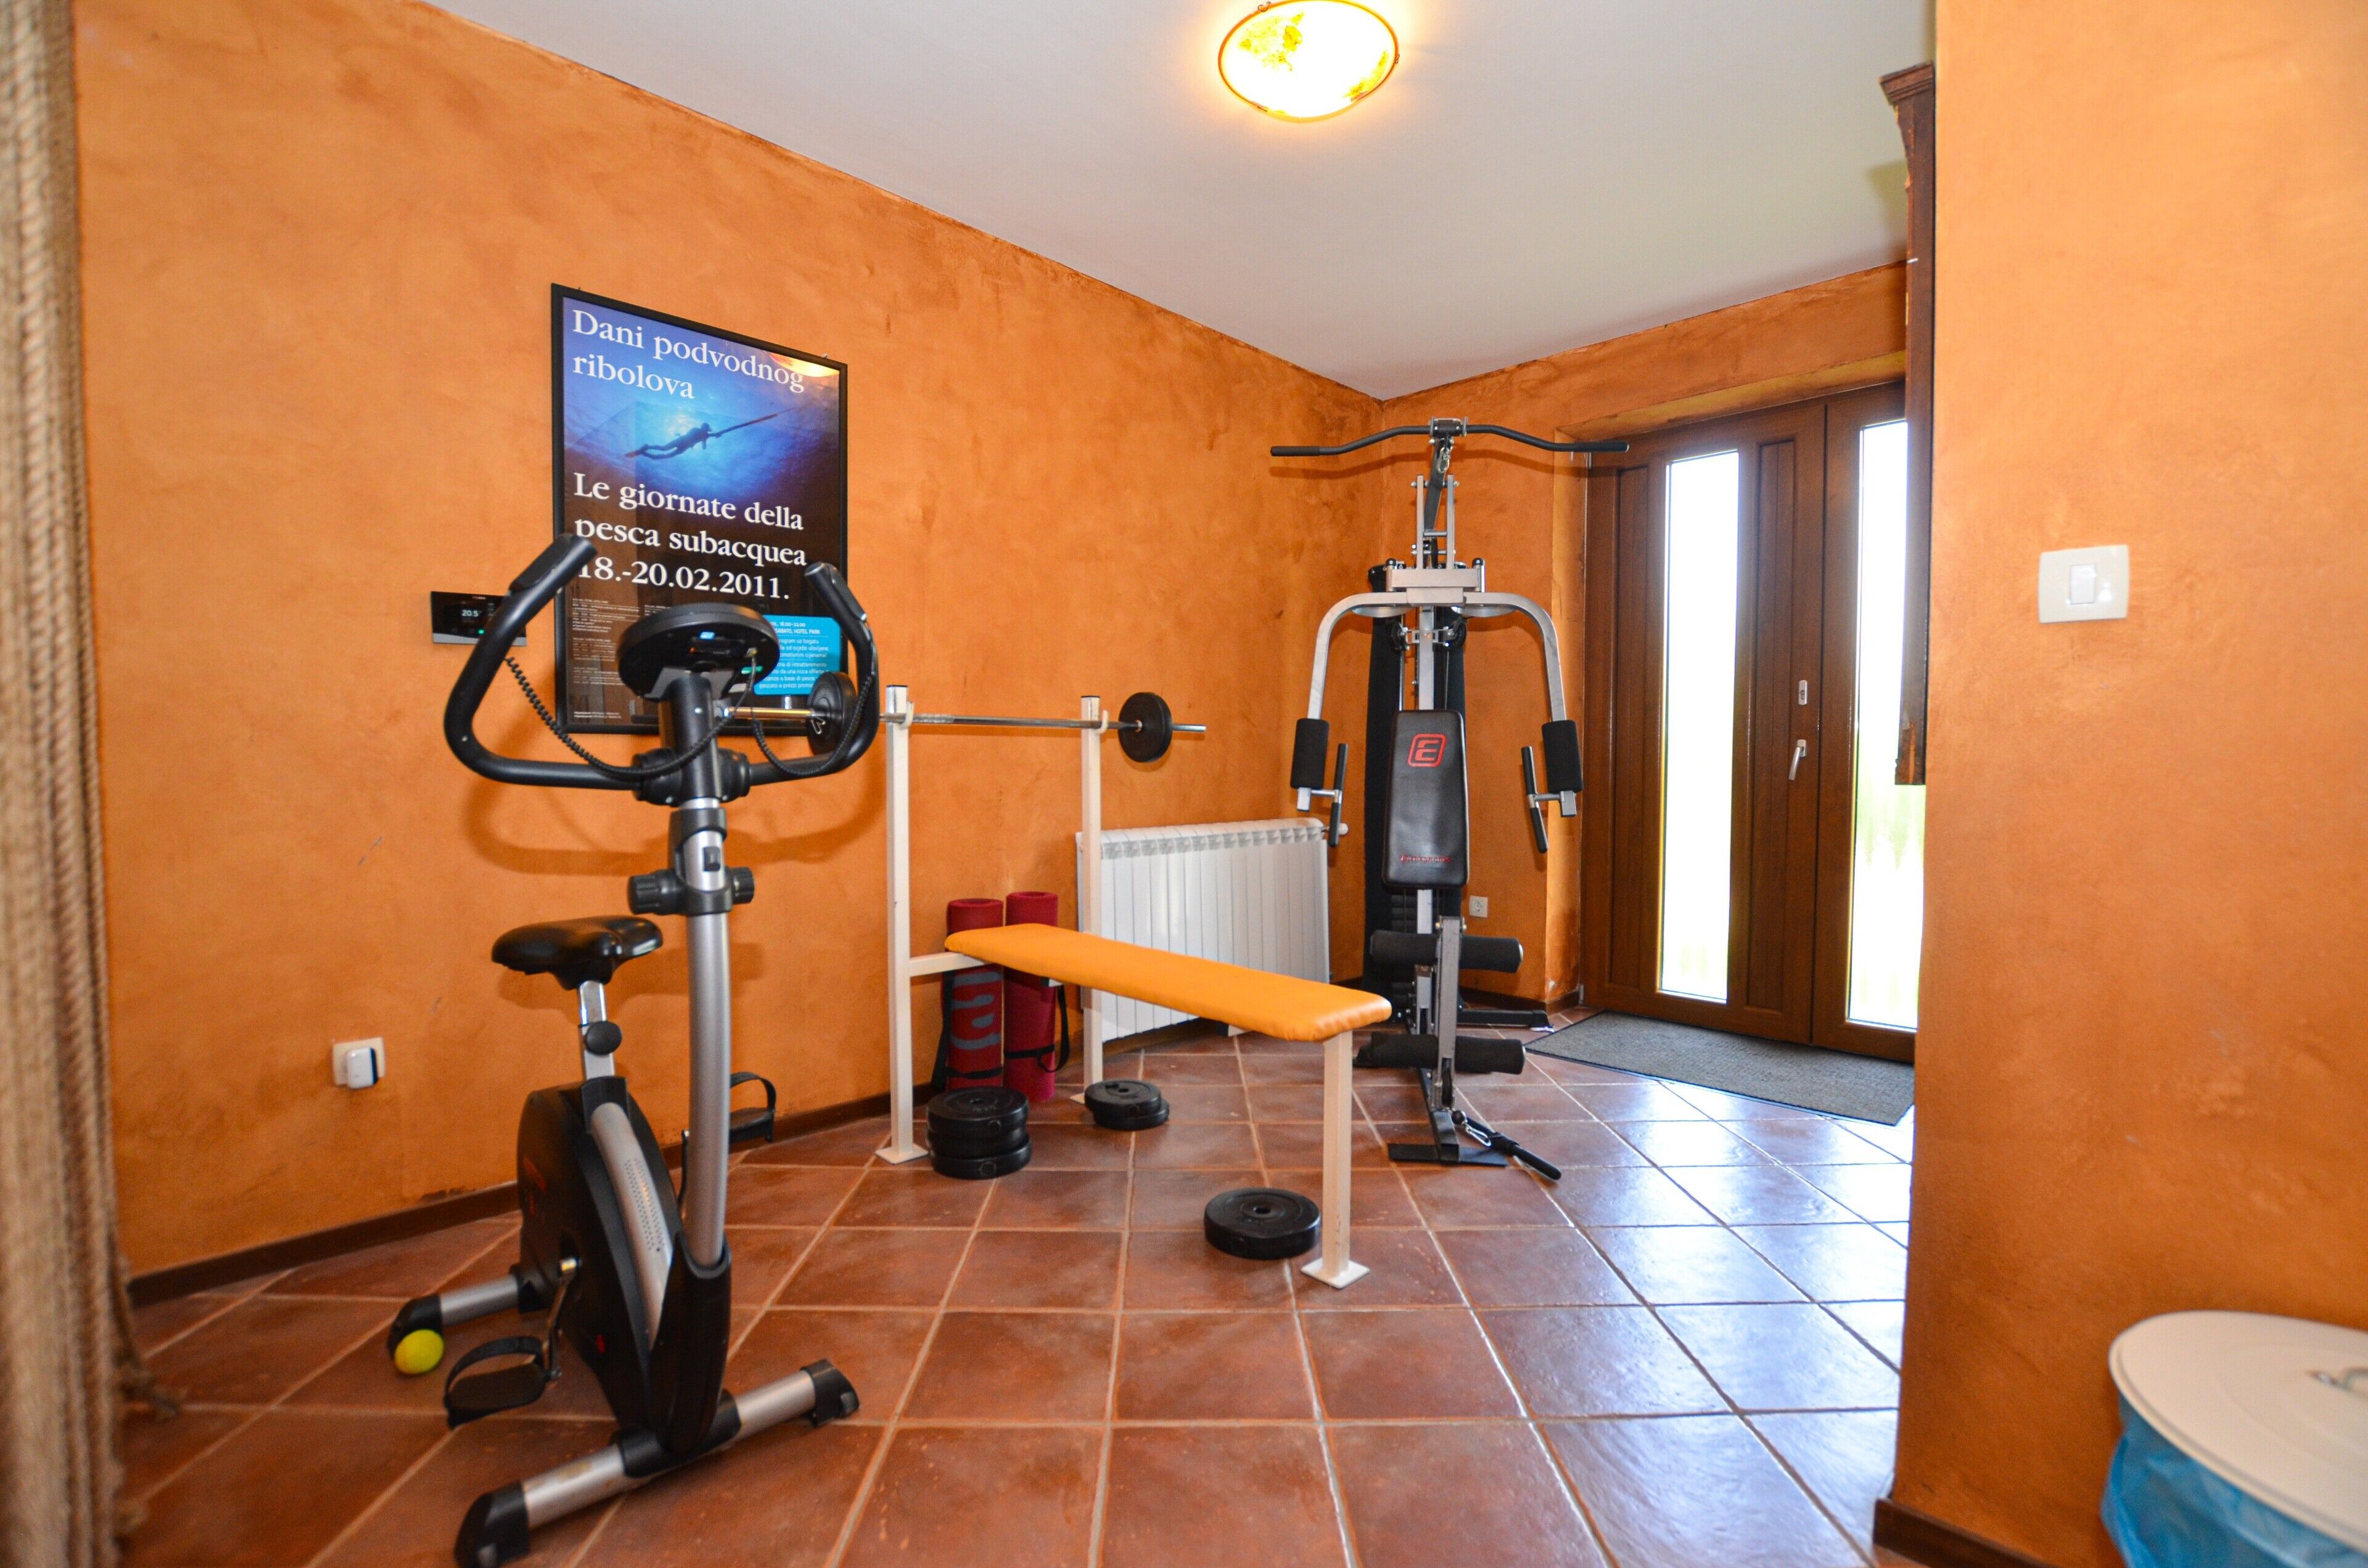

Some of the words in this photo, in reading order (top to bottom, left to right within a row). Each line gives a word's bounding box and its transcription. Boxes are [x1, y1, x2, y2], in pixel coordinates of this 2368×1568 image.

[572, 310, 644, 349] Dani
[652, 335, 805, 395] podvodnog
[572, 353, 694, 400] ribolova
[574, 472, 610, 500] Le
[619, 483, 736, 519] giornate
[744, 502, 804, 530] della
[574, 519, 660, 547] pesca
[668, 530, 807, 567] subacquea
[461, 609, 479, 617] 20.5
